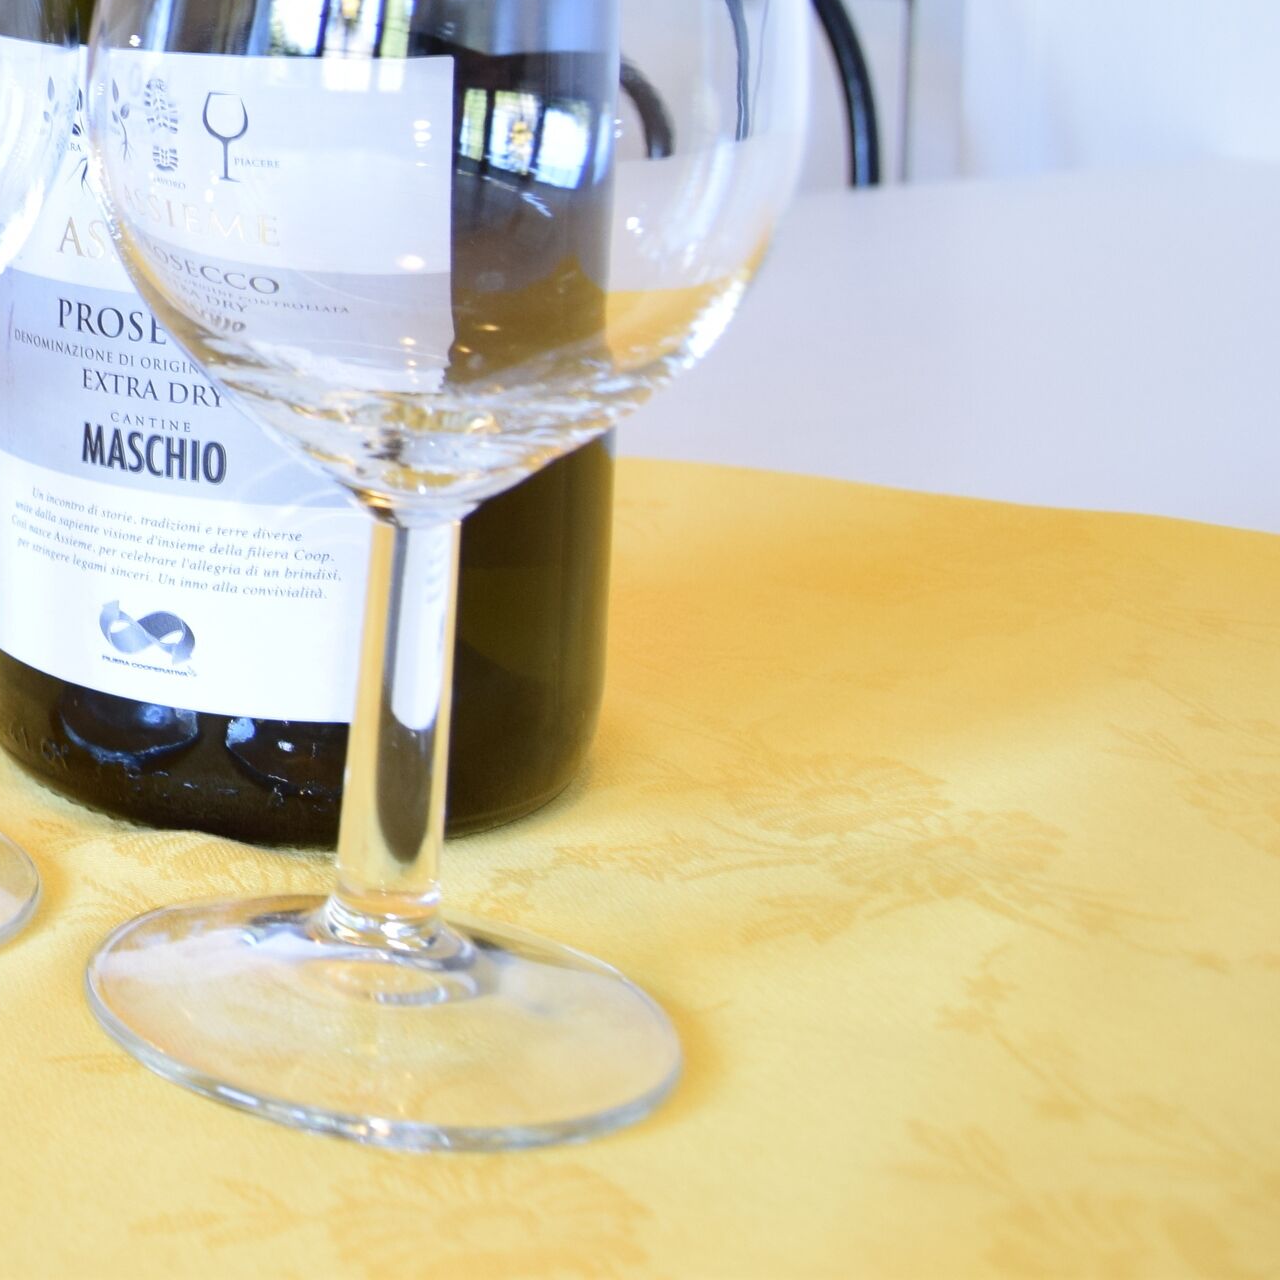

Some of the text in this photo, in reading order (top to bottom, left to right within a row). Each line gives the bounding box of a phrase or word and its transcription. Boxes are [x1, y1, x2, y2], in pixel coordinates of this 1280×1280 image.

[233, 157, 281, 169] PIACERE
[57, 296, 168, 345] PROSE
[14, 328, 201, 375] DENOMINAZIONE DI ORIGIN
[82, 368, 224, 408] EXTRA DRY
[110, 411, 191, 433] CANTINE
[81, 421, 228, 485] MASCHIO
[32, 487, 44, 500] Un
[46, 492, 85, 513] incontro
[87, 504, 98, 517] di
[141, 516, 201, 534] tradizioni
[205, 526, 213, 535] e
[217, 525, 248, 539] terre
[253, 528, 303, 542] diverse
[34, 506, 56, 523] dalla
[59, 516, 100, 537] sapiente
[103, 527, 143, 545] visione
[146, 532, 206, 553] d'insieme
[209, 543, 242, 557] della
[246, 546, 289, 561] filiera
[294, 549, 335, 565] Coop.
[32, 542, 70, 563] stringere
[73, 554, 107, 573] legami
[158, 573, 175, 586] Un
[180, 576, 208, 591] inno
[212, 579, 238, 594] alla
[98, 543, 118, 559] per
[121, 550, 177, 568] celebrare
[181, 556, 241, 576] l'allegria
[245, 565, 258, 577] di
[263, 570, 280, 578] un
